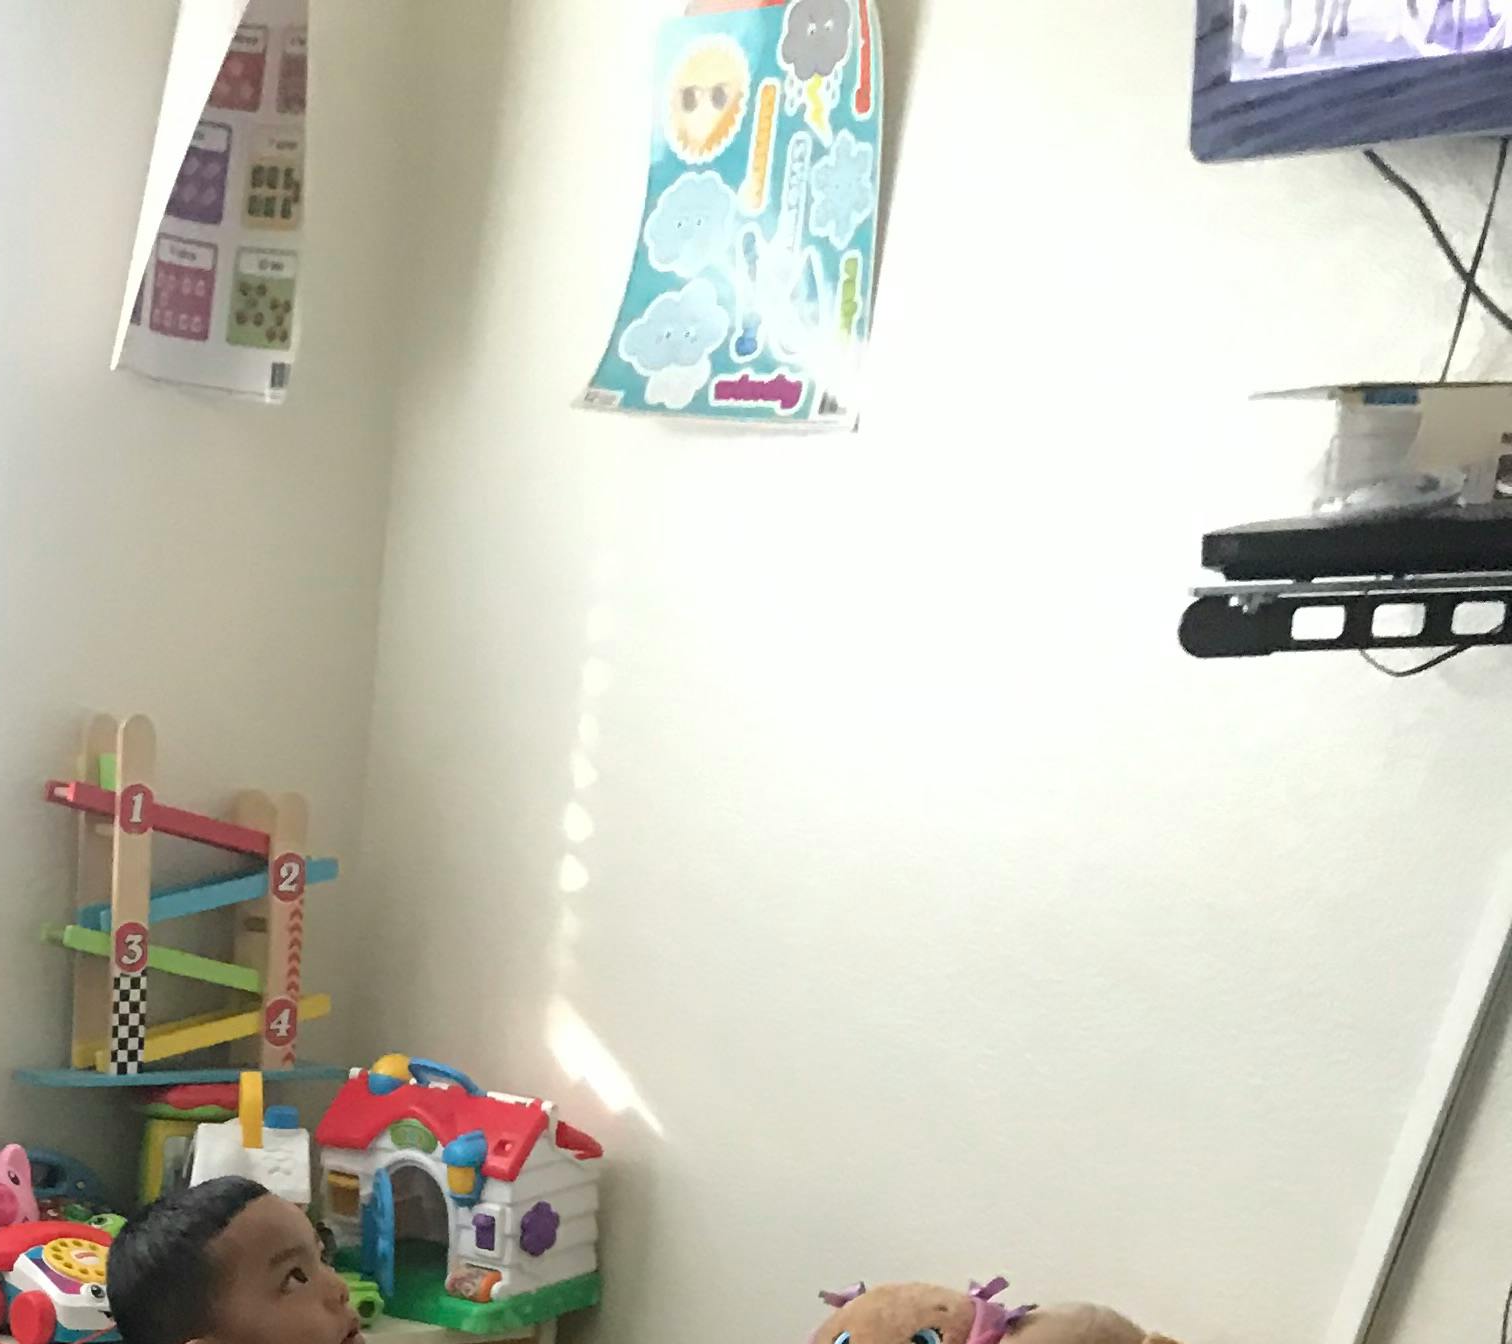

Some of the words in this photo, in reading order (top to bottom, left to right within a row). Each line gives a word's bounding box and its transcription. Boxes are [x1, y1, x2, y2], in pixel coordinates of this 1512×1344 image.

[129, 793, 144, 823] 1
[278, 862, 301, 892] 2
[121, 935, 143, 964] 3
[269, 1008, 291, 1038] 4
